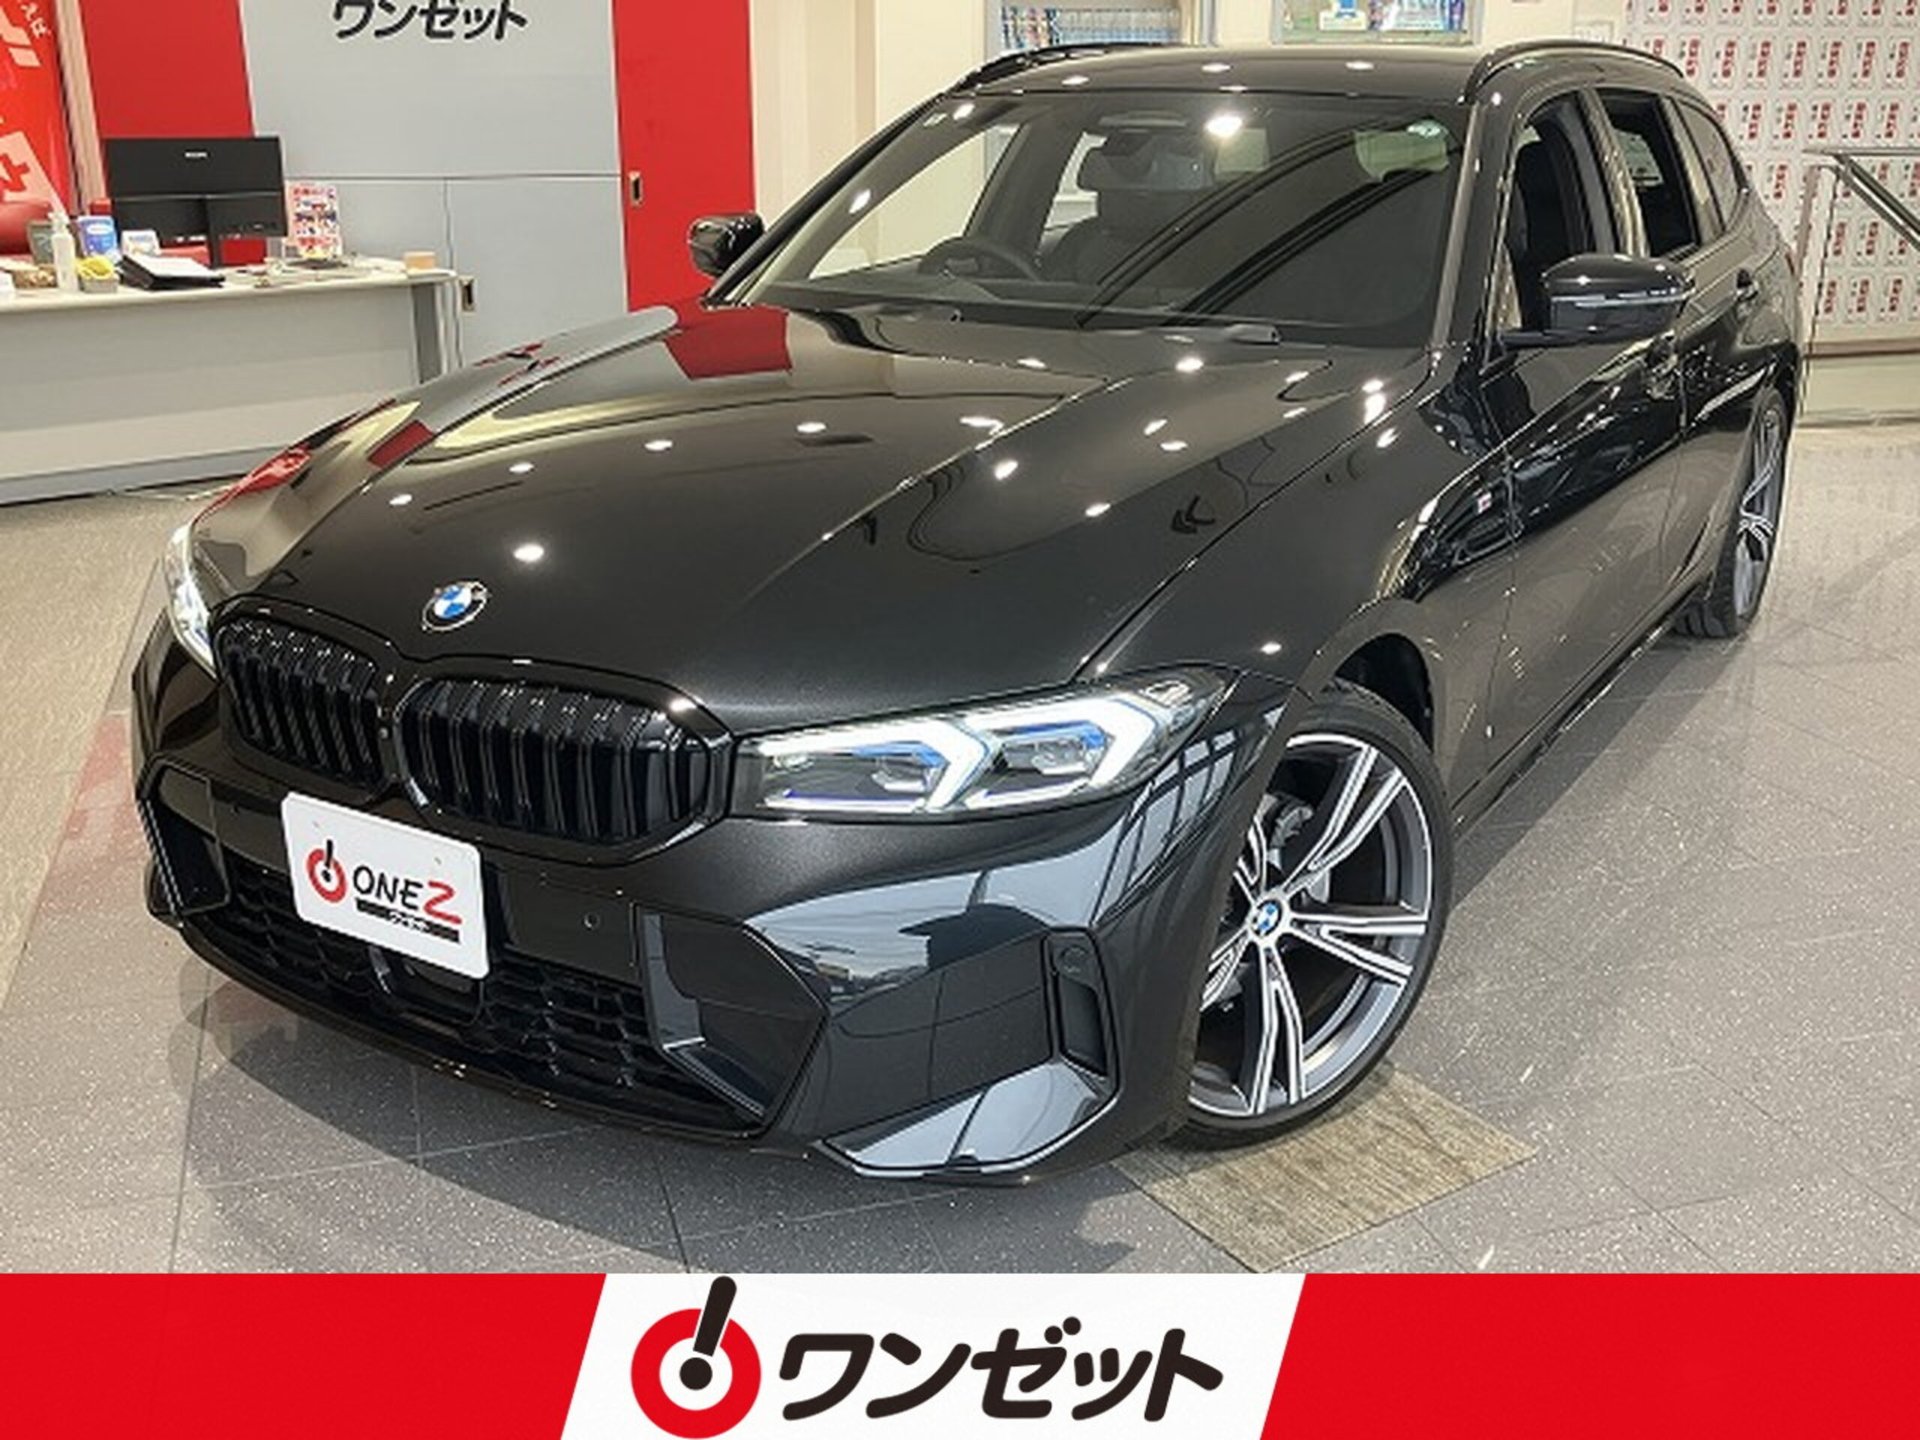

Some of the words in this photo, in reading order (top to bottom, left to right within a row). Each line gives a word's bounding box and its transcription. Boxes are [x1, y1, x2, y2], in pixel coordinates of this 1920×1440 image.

[333, 0, 527, 40] ワンゼット
